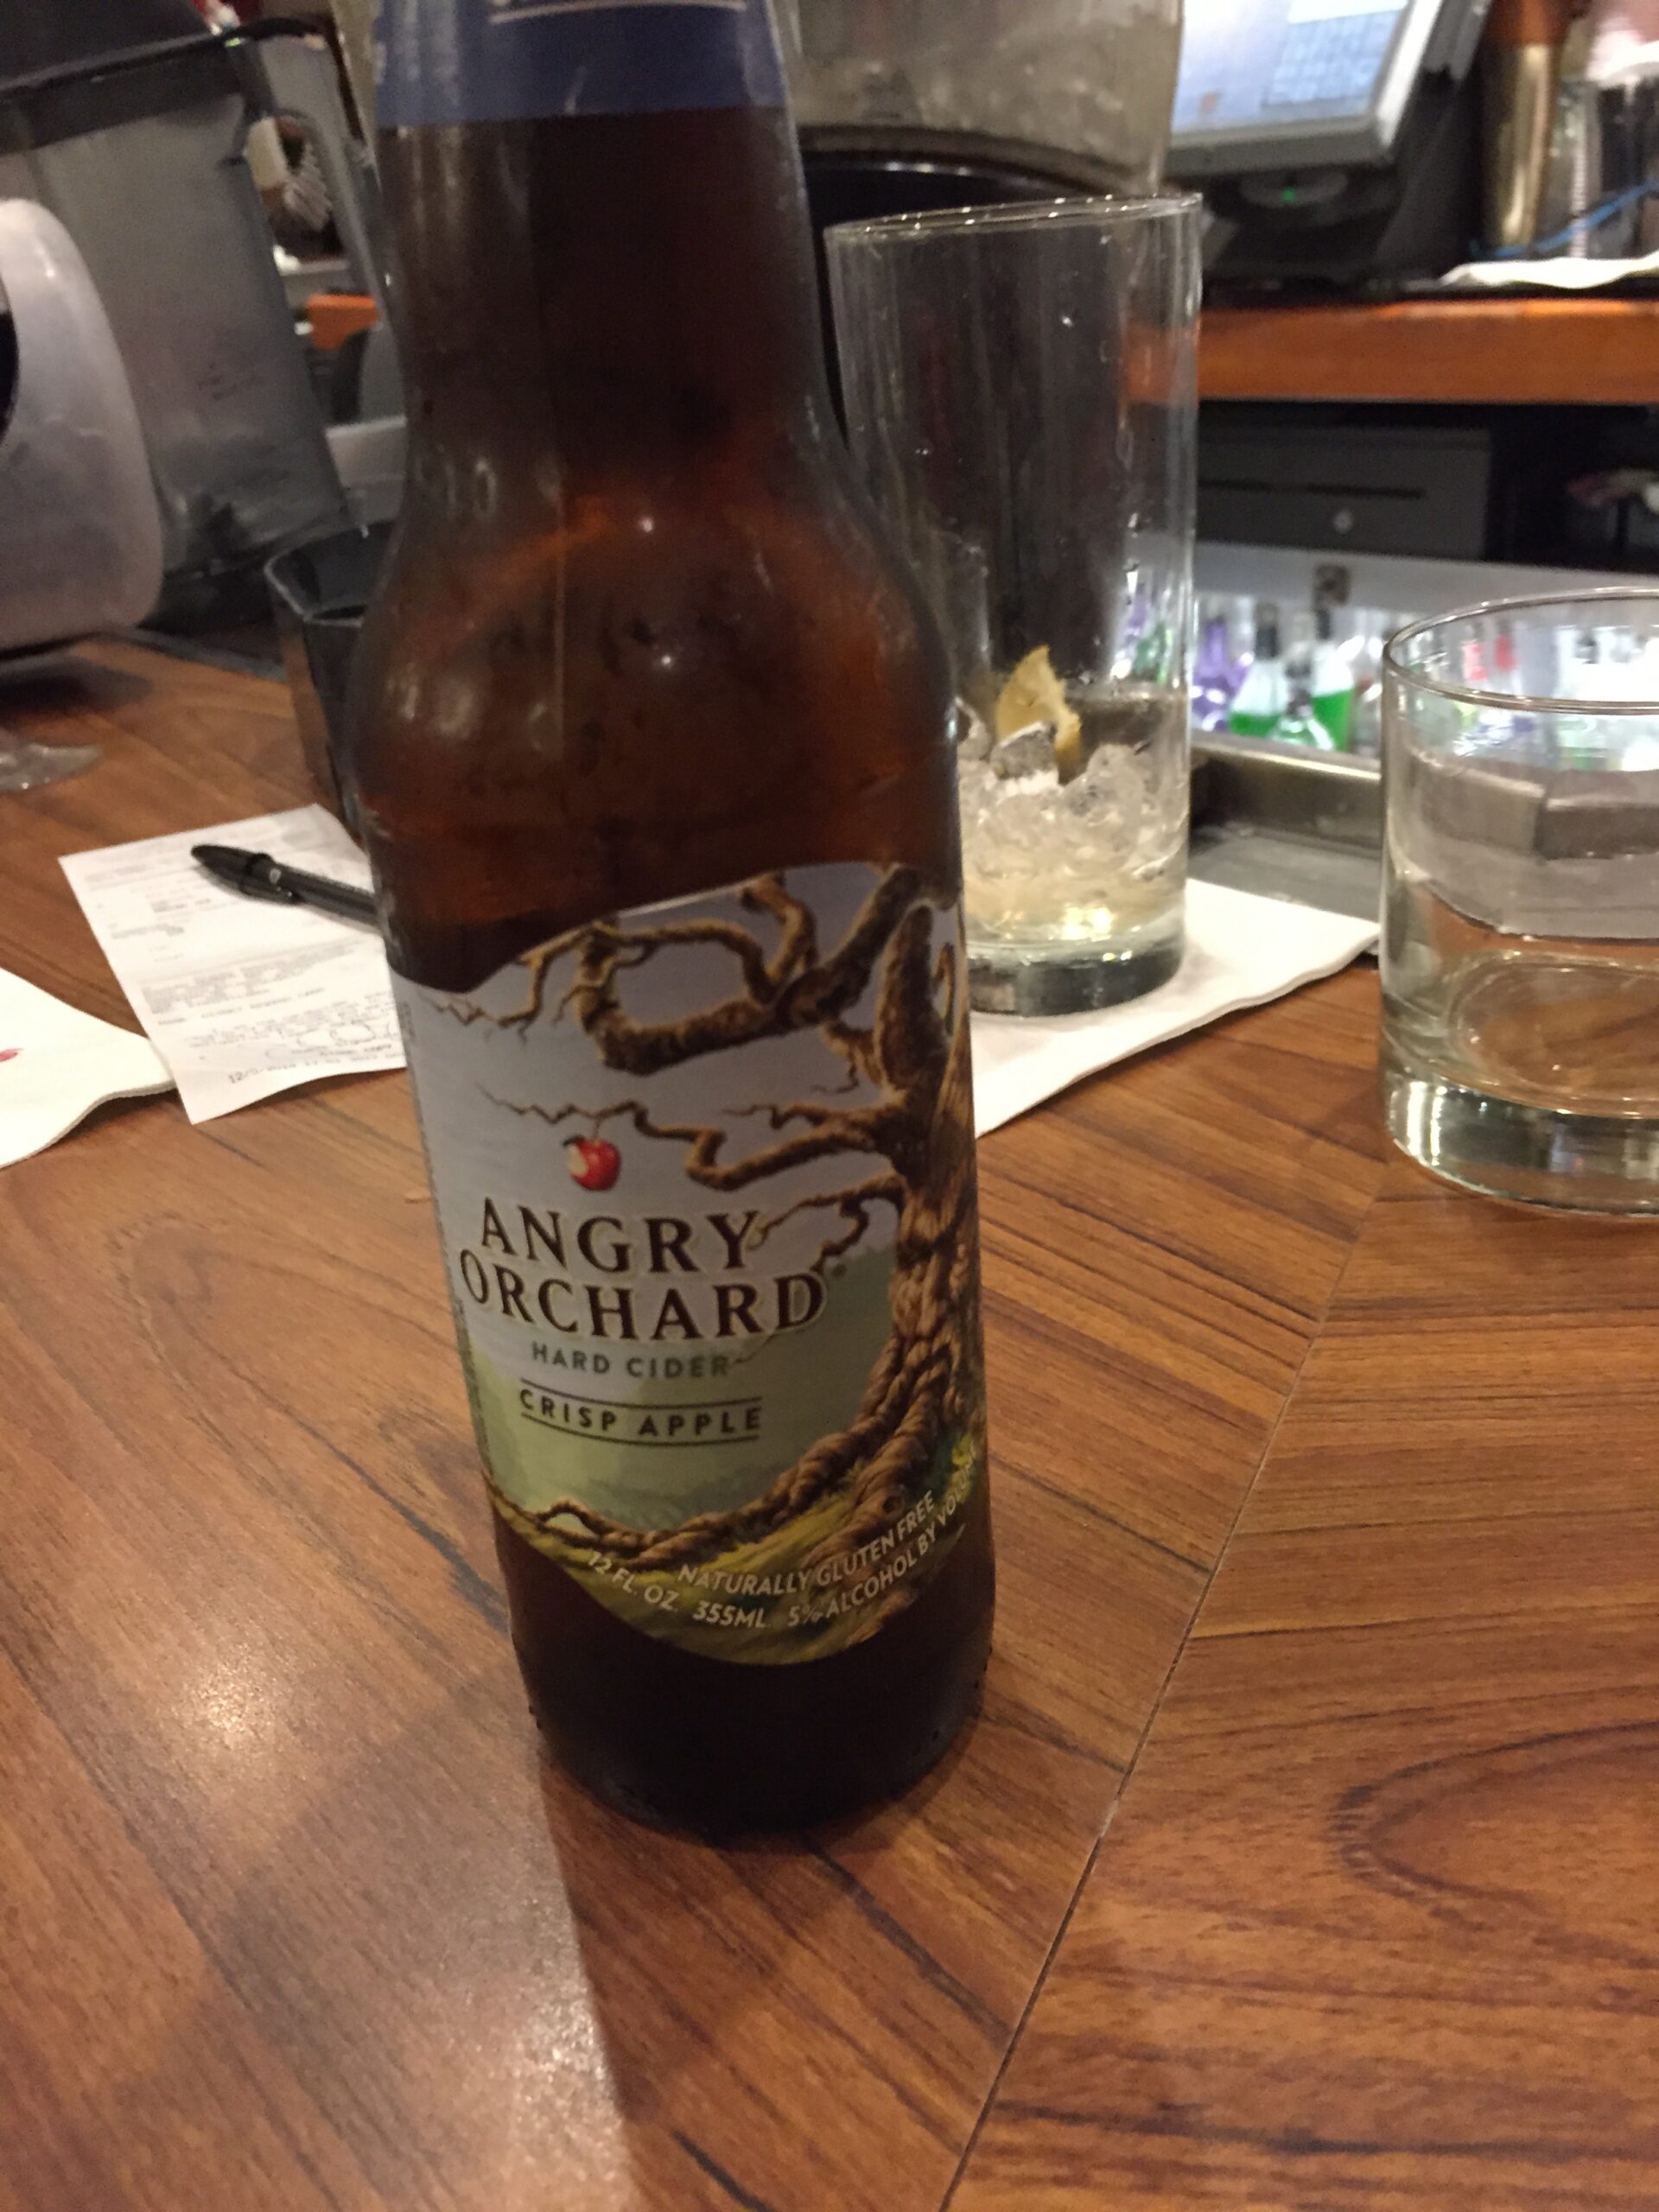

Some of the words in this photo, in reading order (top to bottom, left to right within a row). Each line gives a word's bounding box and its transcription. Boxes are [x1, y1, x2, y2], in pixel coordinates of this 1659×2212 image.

[480, 1197, 760, 1274] ANGRY
[461, 1249, 826, 1340] ORCHARD
[531, 1341, 610, 1374] HARD
[626, 1355, 728, 1378] CIDER
[520, 1389, 616, 1431] CRISP
[639, 1407, 762, 1436] APPLE
[588, 1552, 613, 1574] 12
[788, 1605, 823, 1627] 5%
[826, 1548, 918, 1618] ALCOHOL
[918, 1521, 936, 1555] BY
[678, 1564, 813, 1596] NATURALLY
[816, 1529, 894, 1586] GLUTEN
[897, 1489, 936, 1541] FREE
